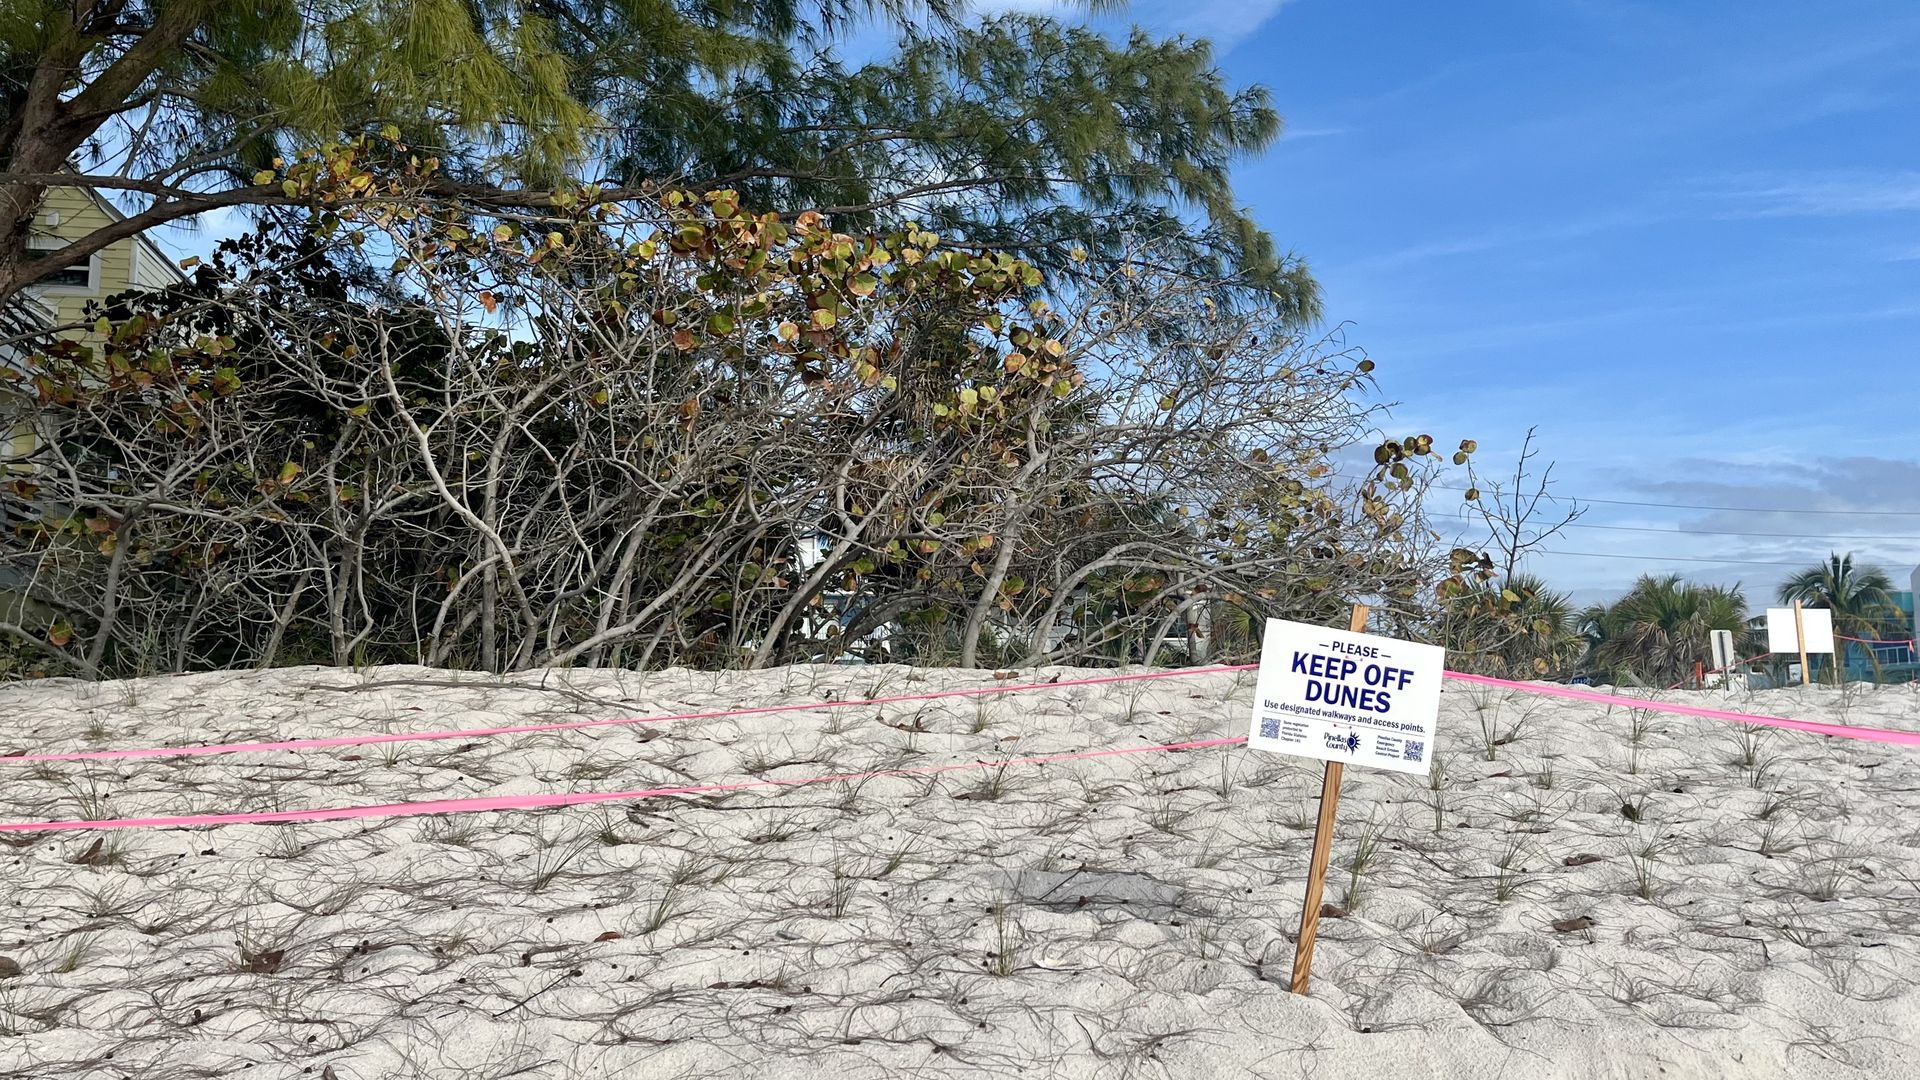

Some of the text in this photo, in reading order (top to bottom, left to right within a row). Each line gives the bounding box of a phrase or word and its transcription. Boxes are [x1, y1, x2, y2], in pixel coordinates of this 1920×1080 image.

[1332, 641, 1378, 658] PLEASE
[1291, 651, 1414, 690] KEEP OFF
[1305, 679, 1391, 713] DUNES
[1264, 699, 1426, 734] Use designated walkways and access points.
[1324, 732, 1346, 743] Pinellas
[1326, 740, 1348, 752] County
